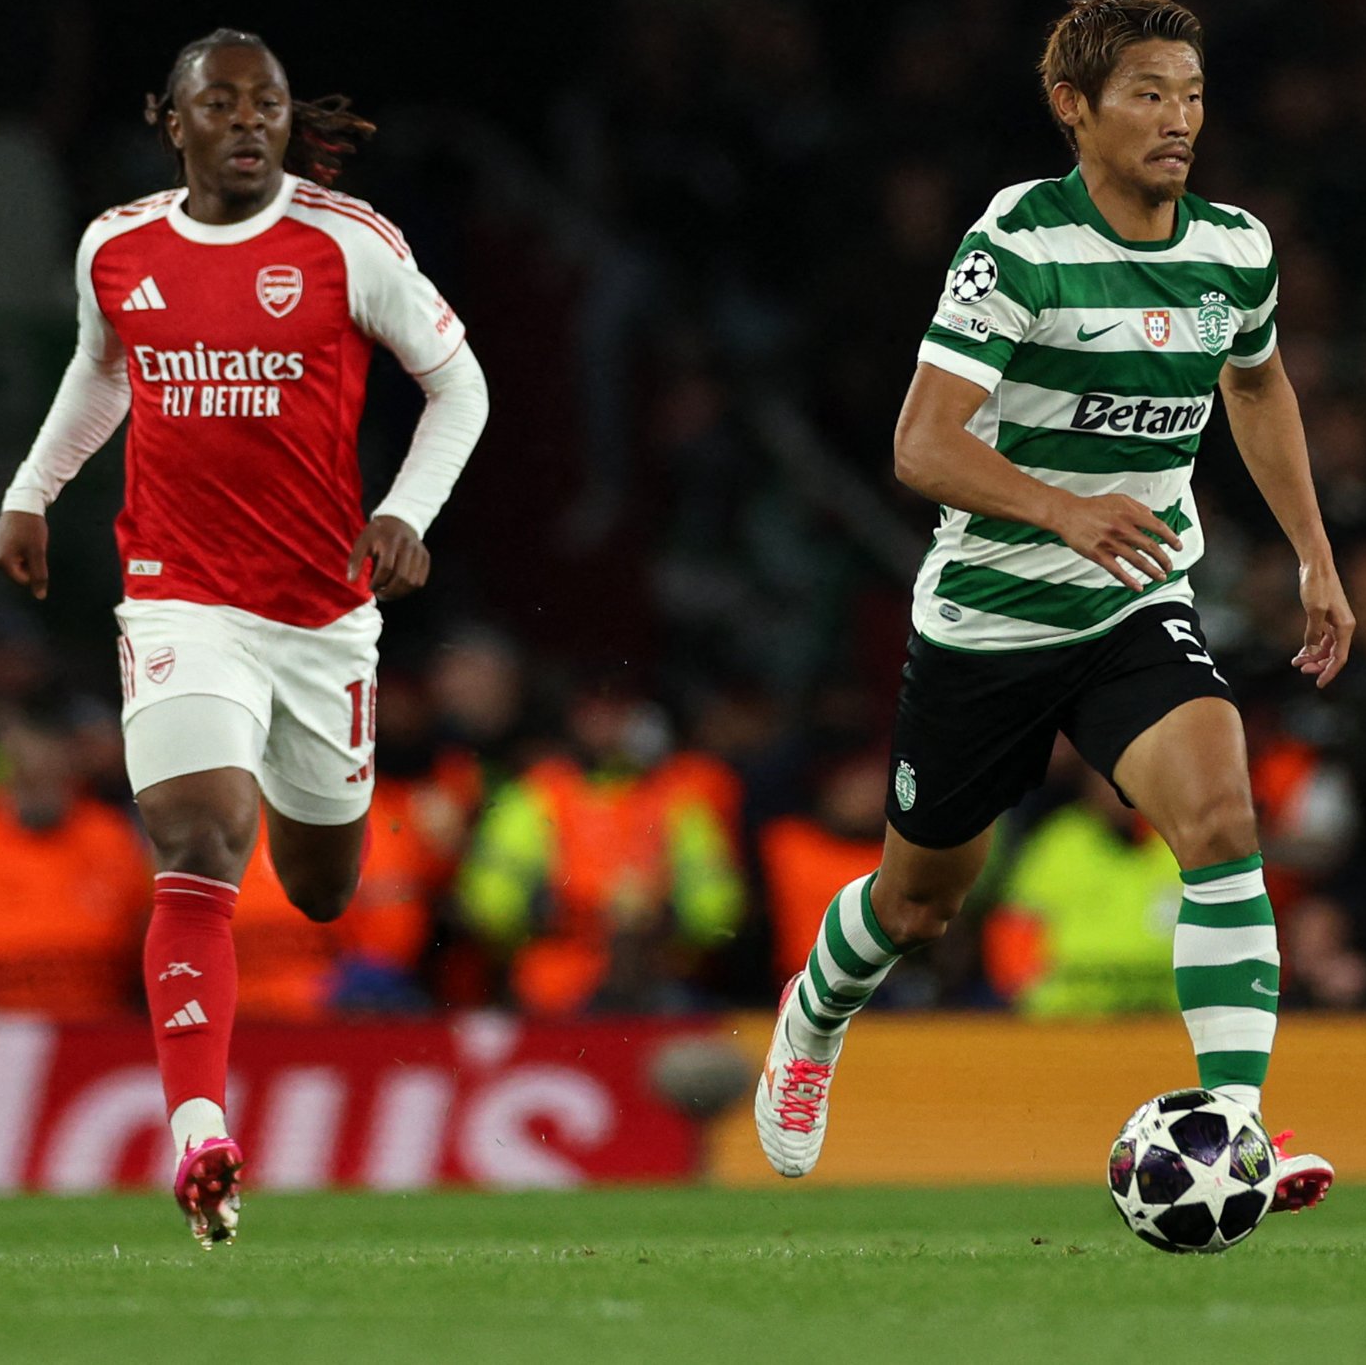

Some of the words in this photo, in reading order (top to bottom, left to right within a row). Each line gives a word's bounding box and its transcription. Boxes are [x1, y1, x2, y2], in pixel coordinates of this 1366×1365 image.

[1200, 291, 1226, 305] SCP
[134, 340, 304, 382] Emirates
[163, 385, 195, 416] FLY
[200, 385, 281, 417] BETTER
[1070, 394, 1206, 434] Betano
[1161, 619, 1214, 665] 5
